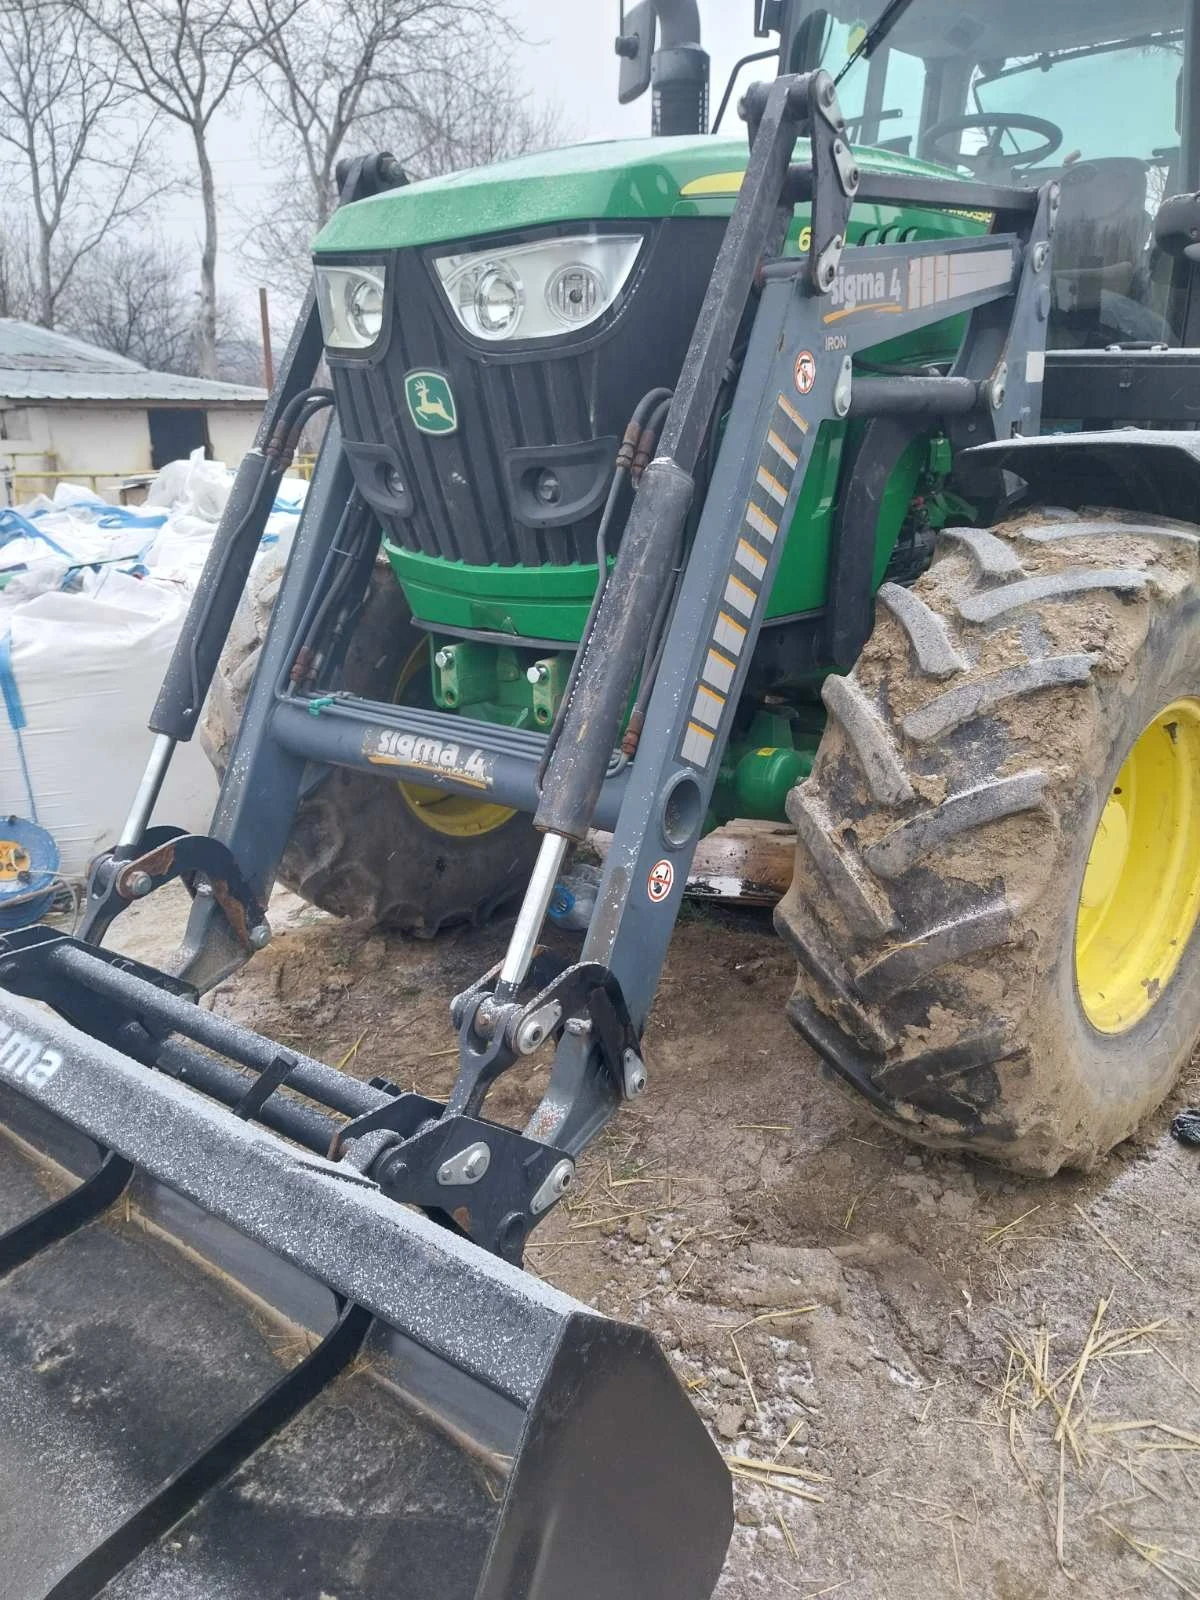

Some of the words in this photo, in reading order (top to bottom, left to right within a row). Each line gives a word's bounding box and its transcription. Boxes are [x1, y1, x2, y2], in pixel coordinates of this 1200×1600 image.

[831, 266, 885, 309] sigma
[889, 267, 901, 301] 4
[825, 335, 847, 351] IRON
[378, 730, 459, 767] sigma
[464, 749, 488, 780] 4
